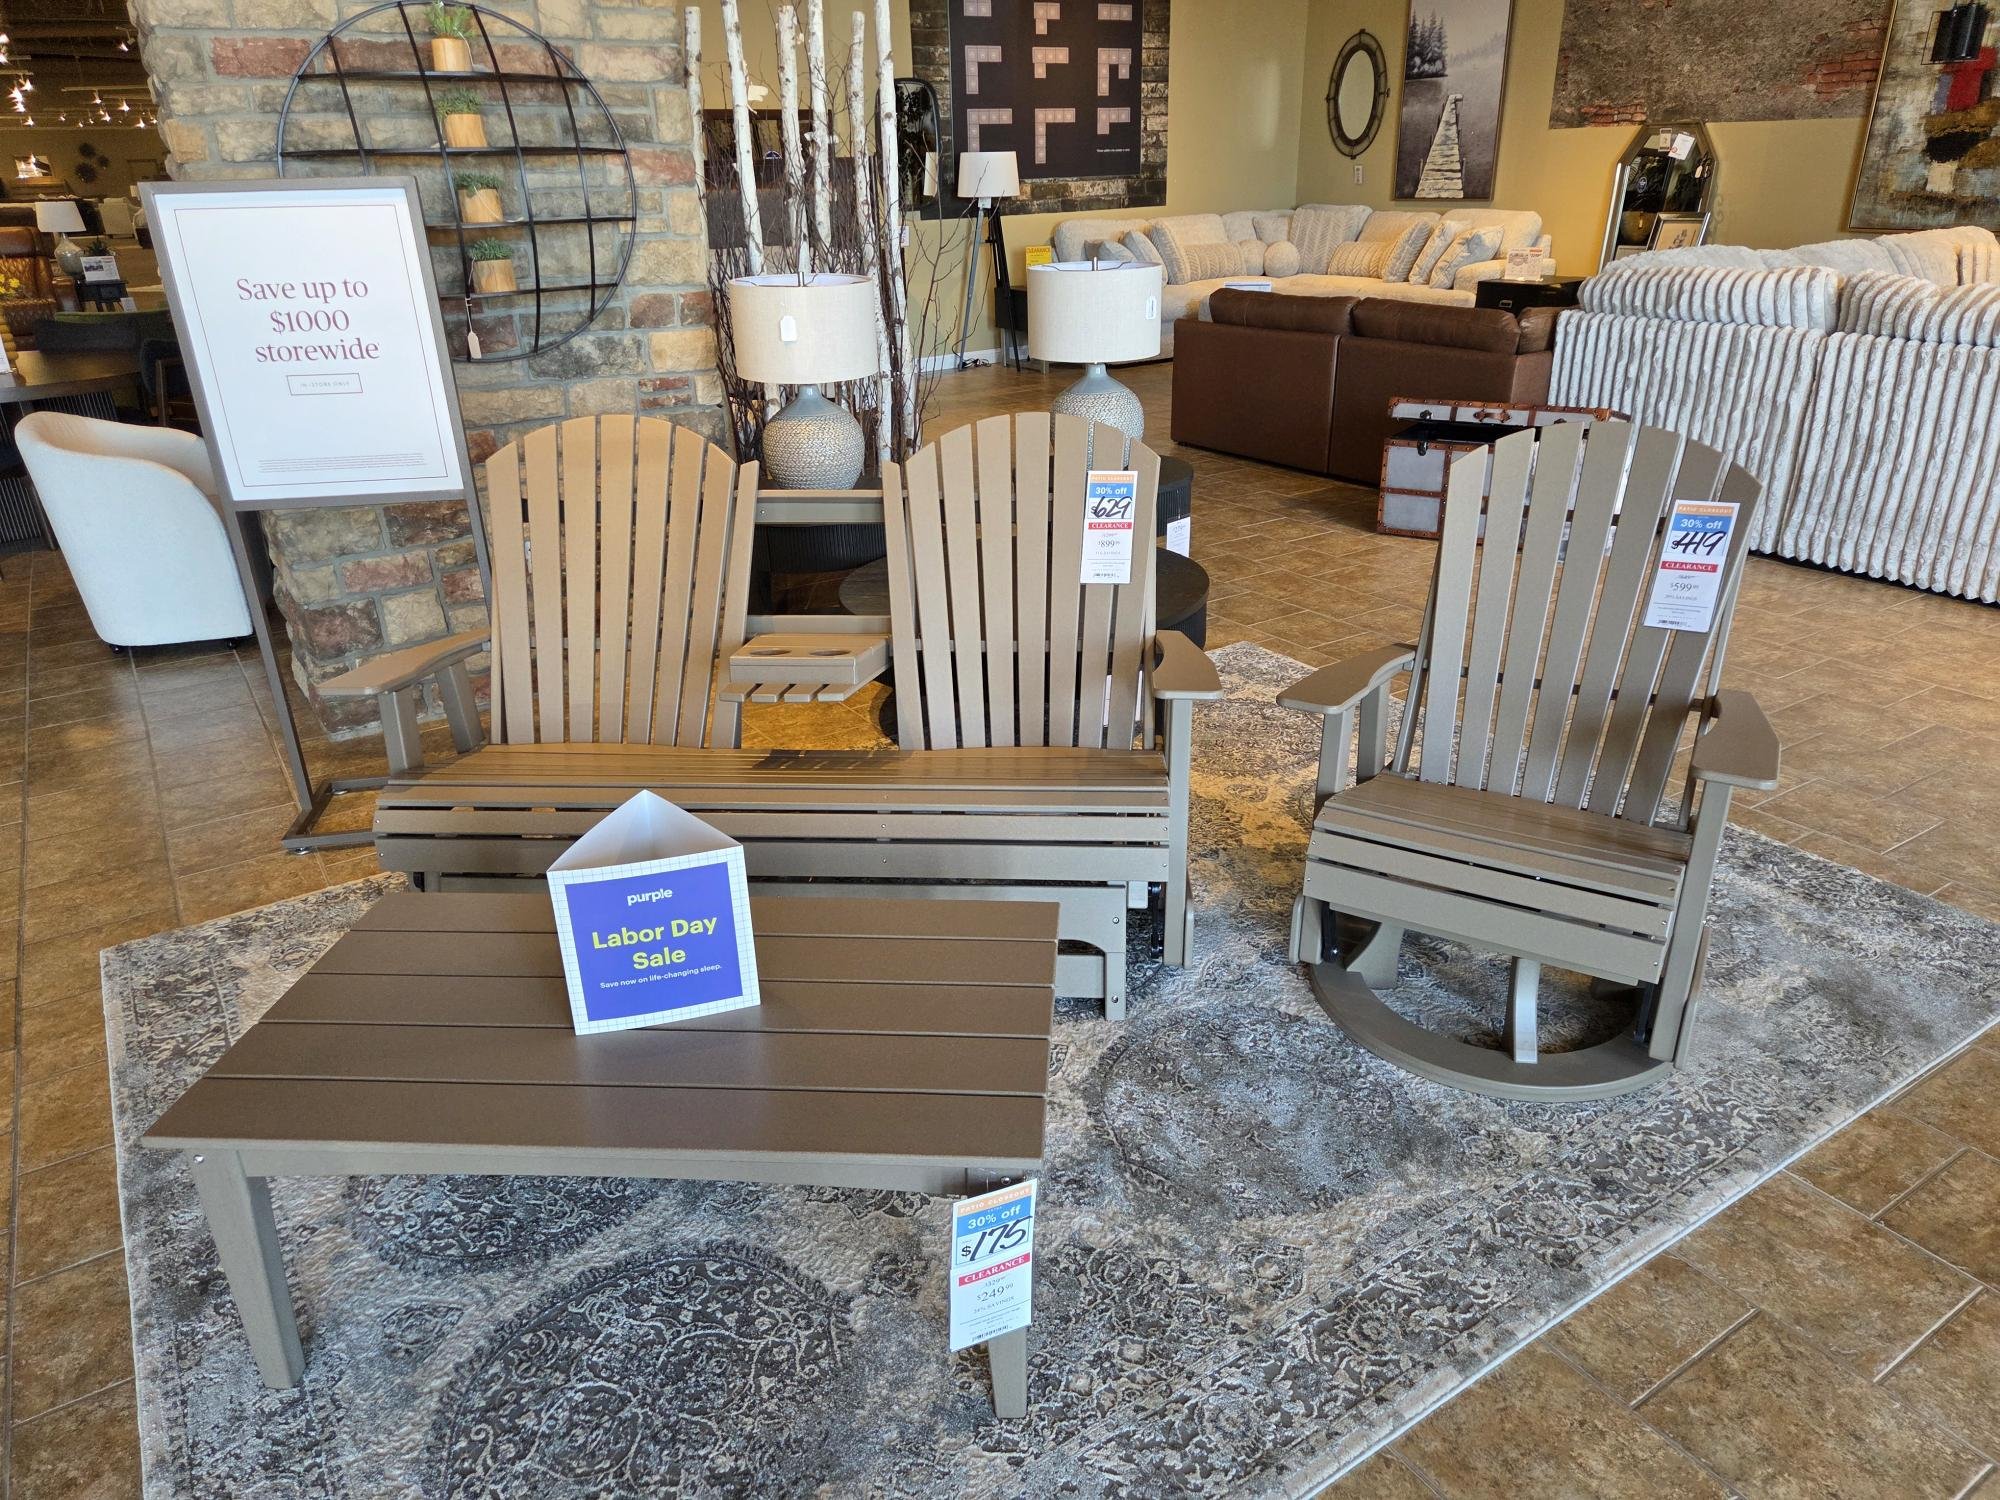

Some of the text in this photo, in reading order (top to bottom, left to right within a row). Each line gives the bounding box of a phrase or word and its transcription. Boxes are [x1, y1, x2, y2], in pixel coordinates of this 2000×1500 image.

[236, 278, 369, 304] Save up to
[270, 309, 350, 334] $1000
[1095, 486, 1127, 495] 30% off
[1681, 518, 1722, 529] 30% off
[1671, 531, 1727, 556] $419
[1665, 562, 1713, 571] CLEARANCE
[627, 888, 673, 906] purple
[592, 917, 717, 949] Labor Day
[633, 947, 686, 969] Sale
[600, 980, 619, 989] Save
[649, 968, 699, 982] life-changing
[700, 963, 723, 973] sleep.
[968, 1213, 997, 1229] 30%
[1001, 1204, 1021, 1219] off
[961, 1216, 1033, 1261] $175
[964, 1256, 1025, 1283] CLEARANCE
